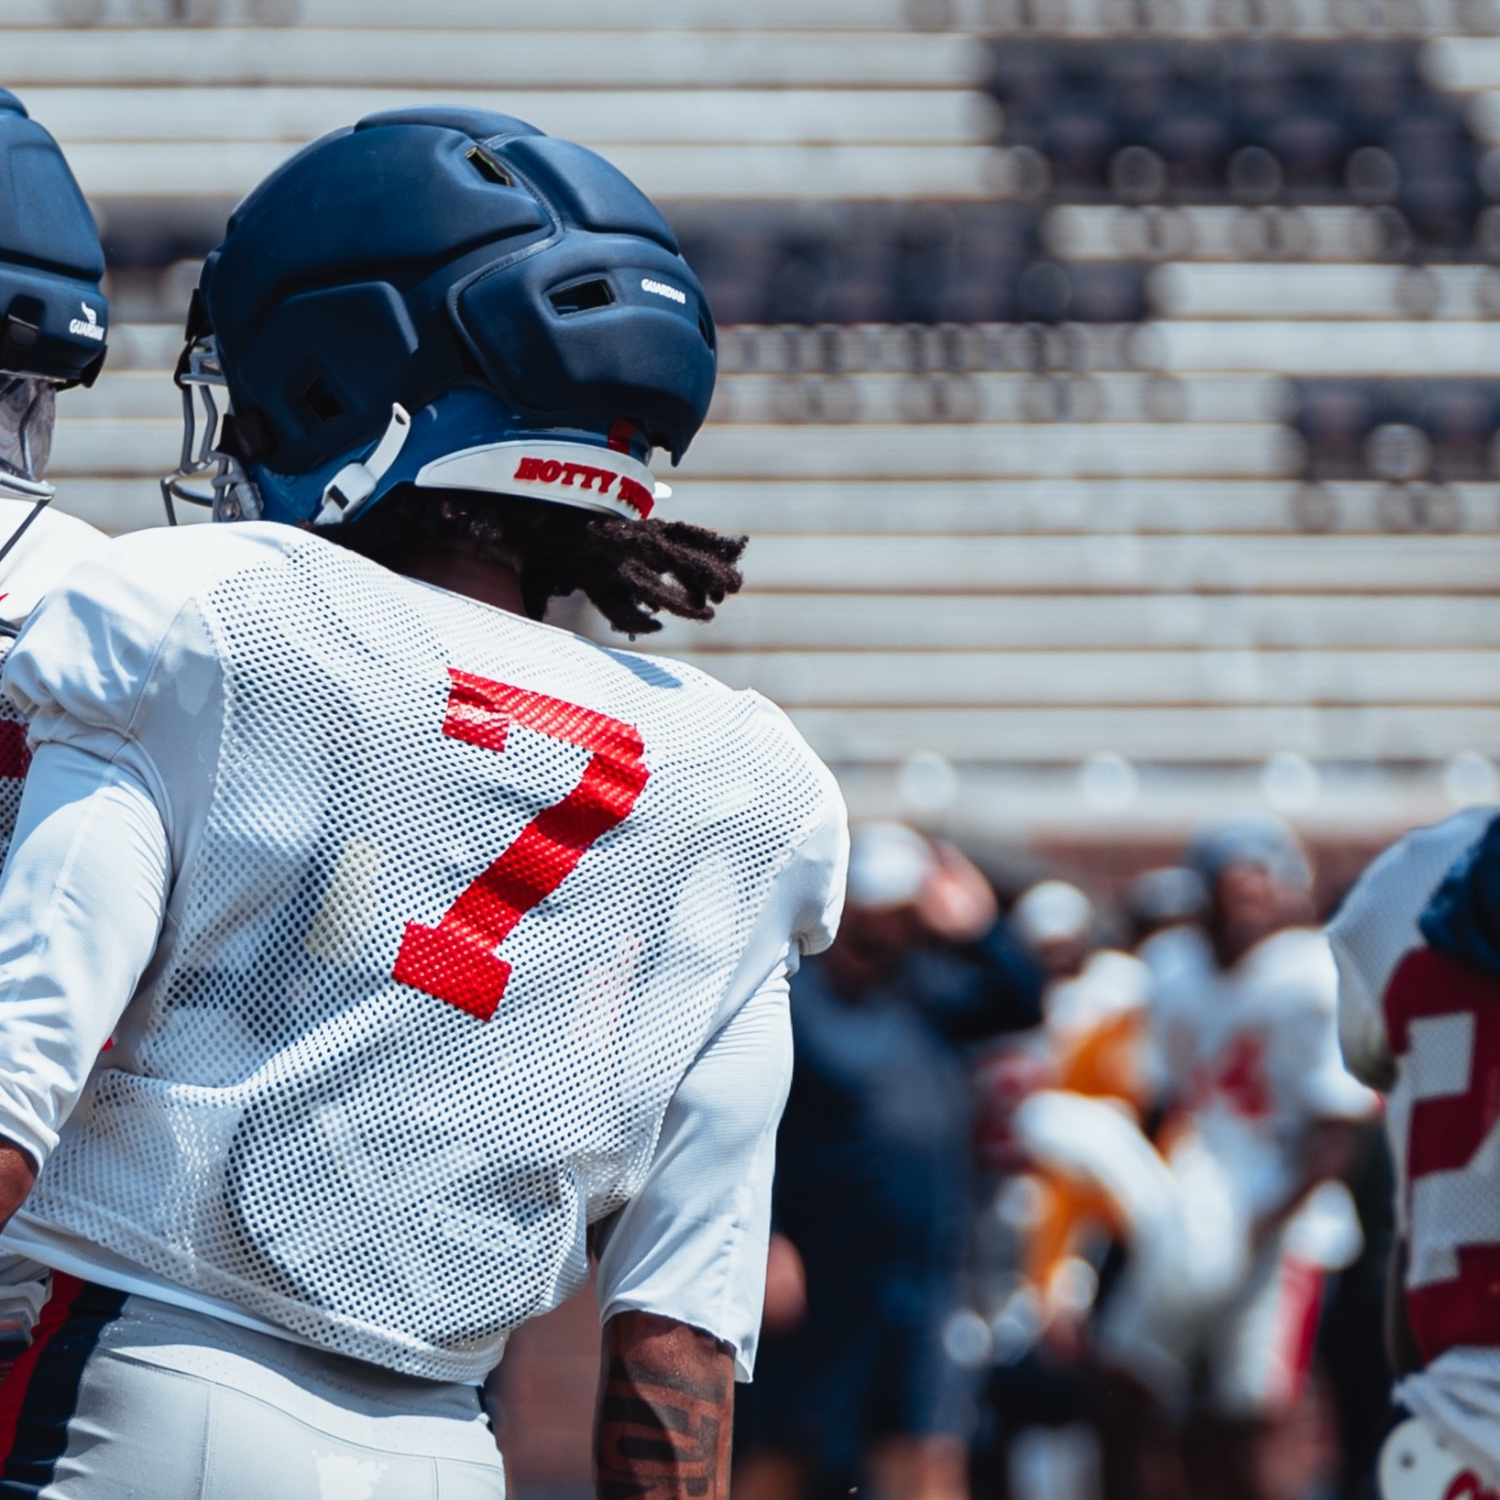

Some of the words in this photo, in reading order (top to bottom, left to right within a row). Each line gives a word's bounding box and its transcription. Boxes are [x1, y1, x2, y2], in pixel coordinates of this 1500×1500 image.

[641, 278, 686, 304] GUARDIAN
[513, 457, 618, 494] HOTTY
[391, 667, 652, 1023] 7
